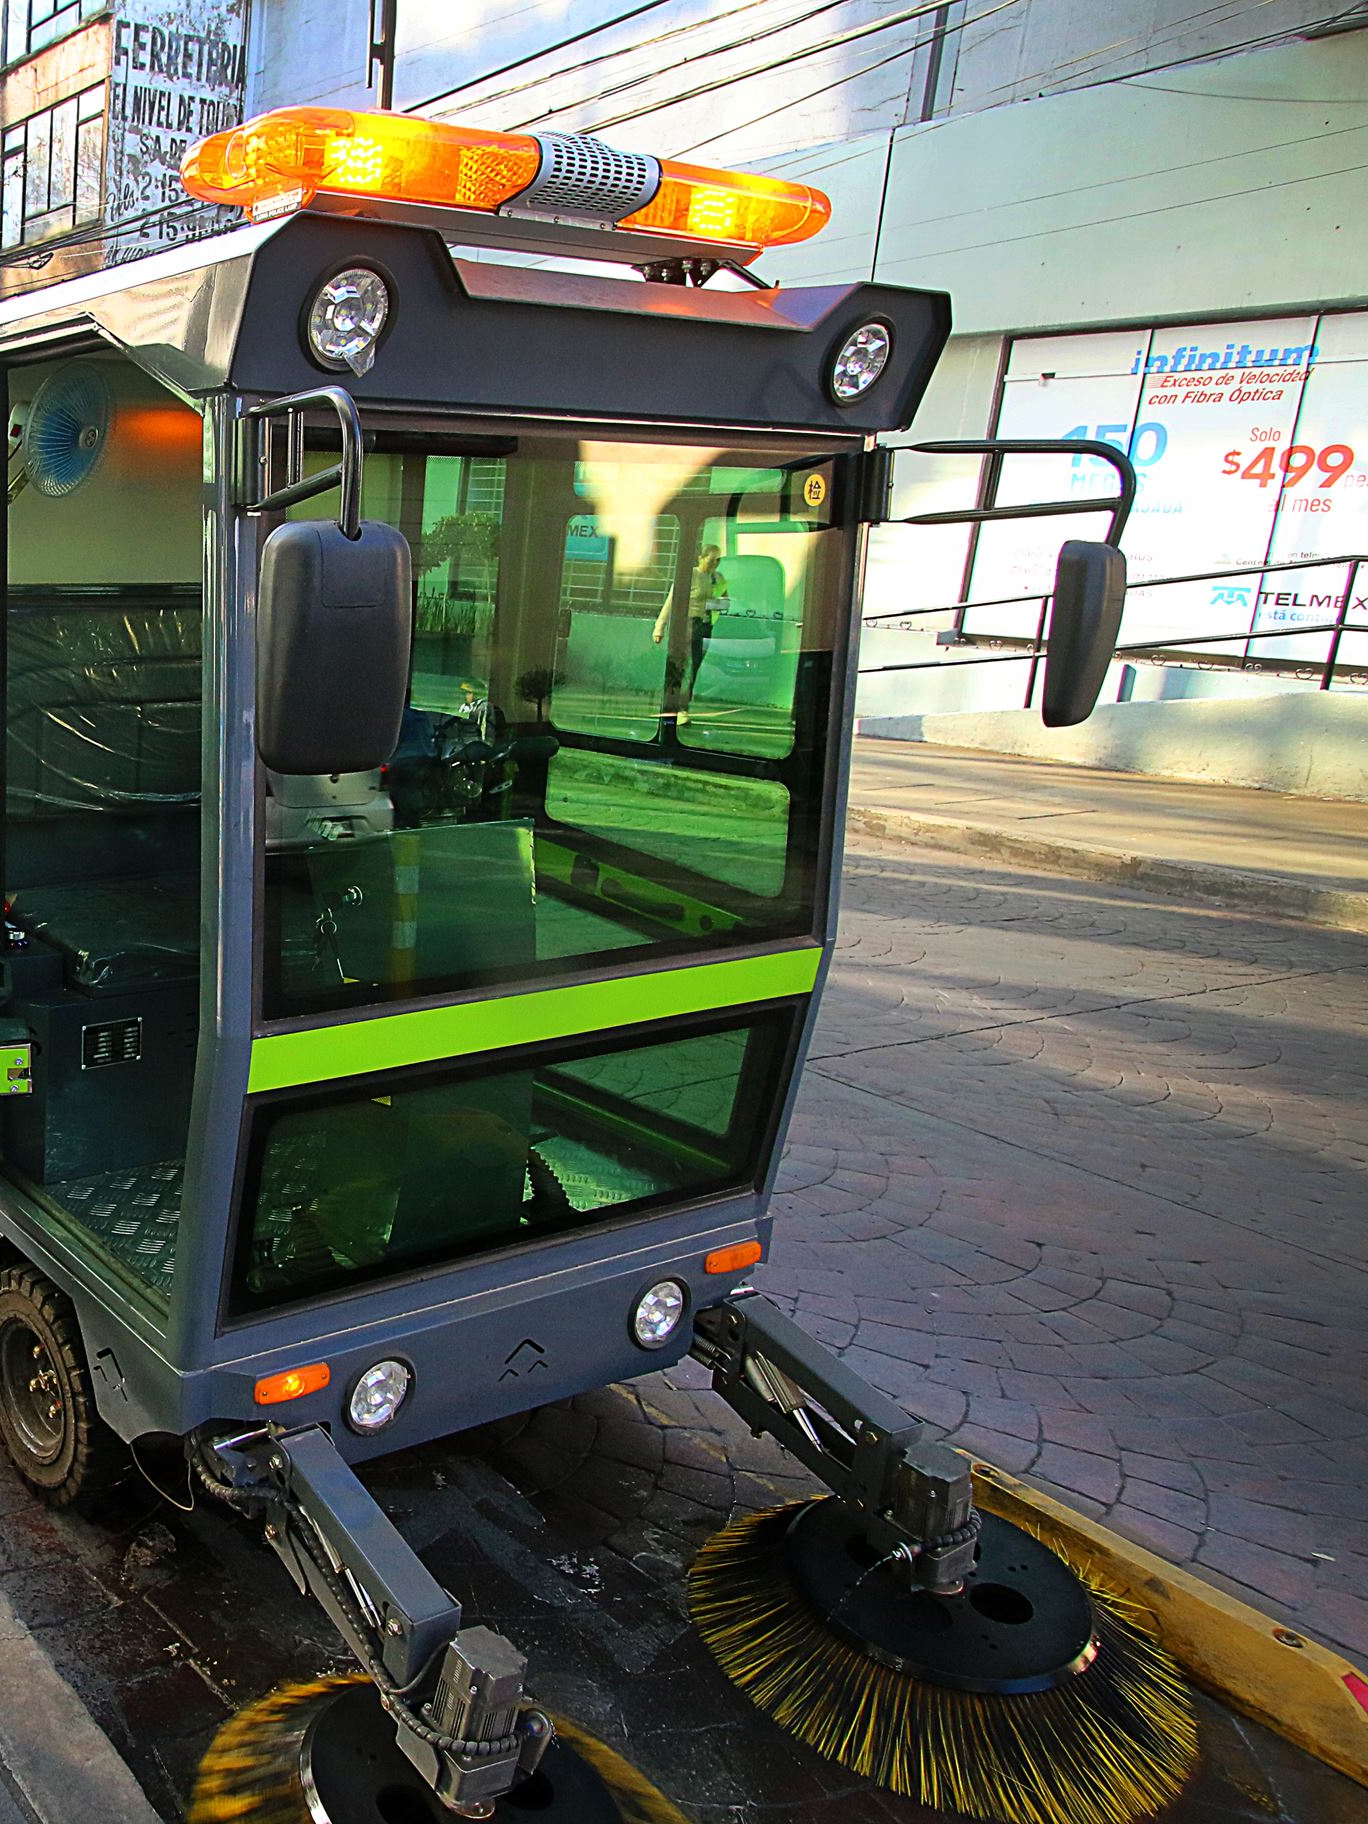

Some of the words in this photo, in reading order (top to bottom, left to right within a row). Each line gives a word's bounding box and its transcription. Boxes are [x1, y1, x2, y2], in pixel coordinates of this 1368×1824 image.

[131, 84, 173, 130] NIVEL
[177, 93, 196, 134] DE
[1131, 342, 1321, 375] infinitum
[1160, 374, 1213, 388] Exceso
[1214, 372, 1234, 387] de
[1239, 366, 1315, 385] Velocidad
[1148, 393, 1178, 405] con
[1181, 388, 1224, 405] Fibra
[1228, 385, 1284, 405] Óptica
[1061, 421, 1169, 468] 150
[1249, 426, 1281, 443] Solo
[1221, 443, 1356, 489] $499
[1344, 474, 1368, 492] pe
[1069, 472, 1147, 494] MEGS
[1290, 497, 1332, 513] mes
[1259, 590, 1368, 611] TELMEX
